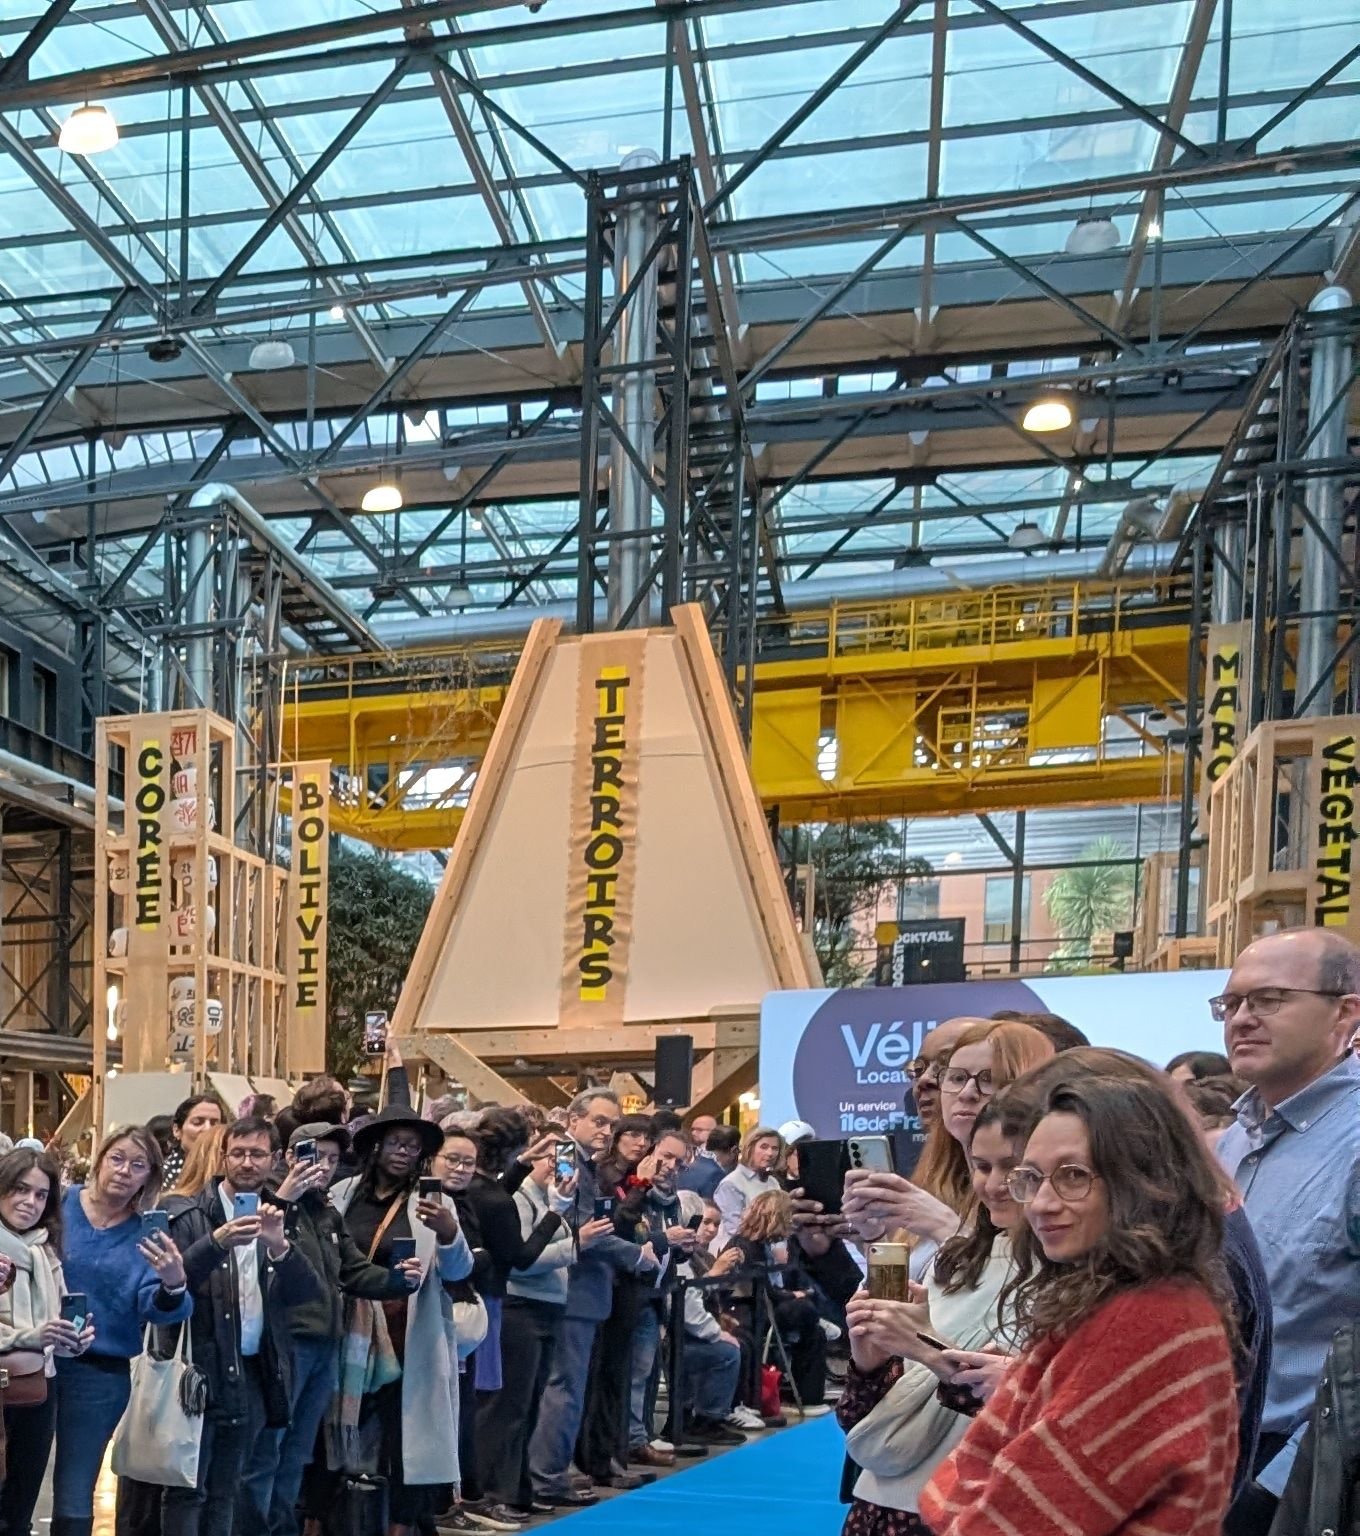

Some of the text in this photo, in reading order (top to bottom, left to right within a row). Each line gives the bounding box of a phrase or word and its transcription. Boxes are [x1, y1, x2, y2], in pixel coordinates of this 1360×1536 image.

[135, 747, 166, 925] CORÉE
[579, 677, 631, 988] TERROIRS
[296, 782, 325, 1008] BOLIVIE
[898, 930, 954, 945] CKTAIL
[840, 1021, 937, 1069] Vél
[839, 1101, 897, 1113] Un service
